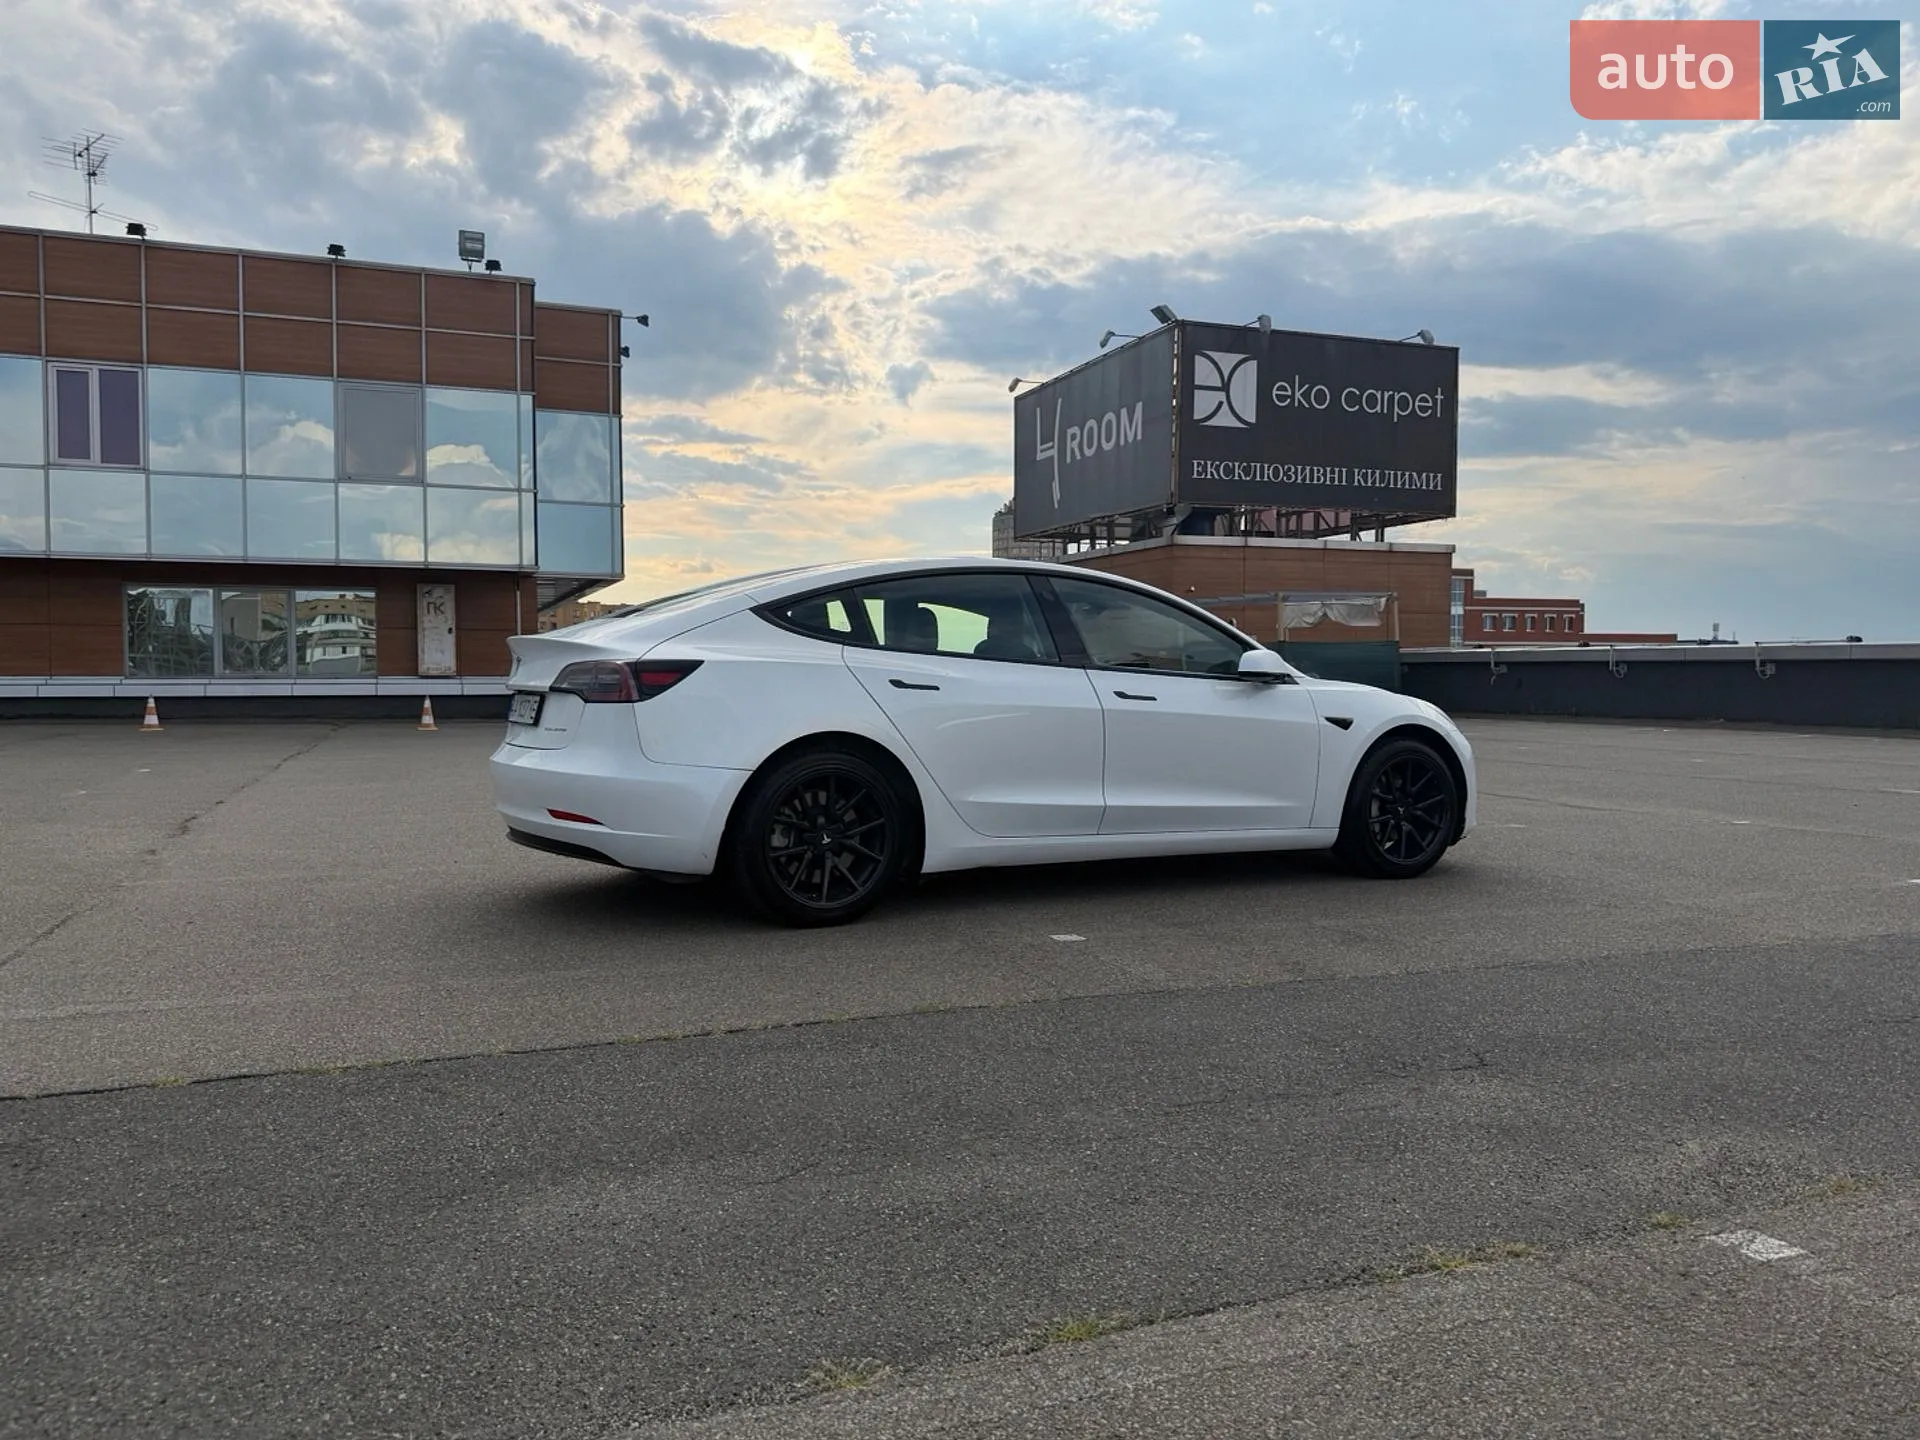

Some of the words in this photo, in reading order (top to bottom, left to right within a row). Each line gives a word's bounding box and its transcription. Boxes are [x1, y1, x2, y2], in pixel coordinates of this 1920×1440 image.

[1271, 375, 1331, 410] eko
[1341, 386, 1445, 423] carpet
[1191, 459, 1349, 486] ЕКСКЛЮЗИВНІ
[1353, 468, 1444, 491] КИЛИМИ
